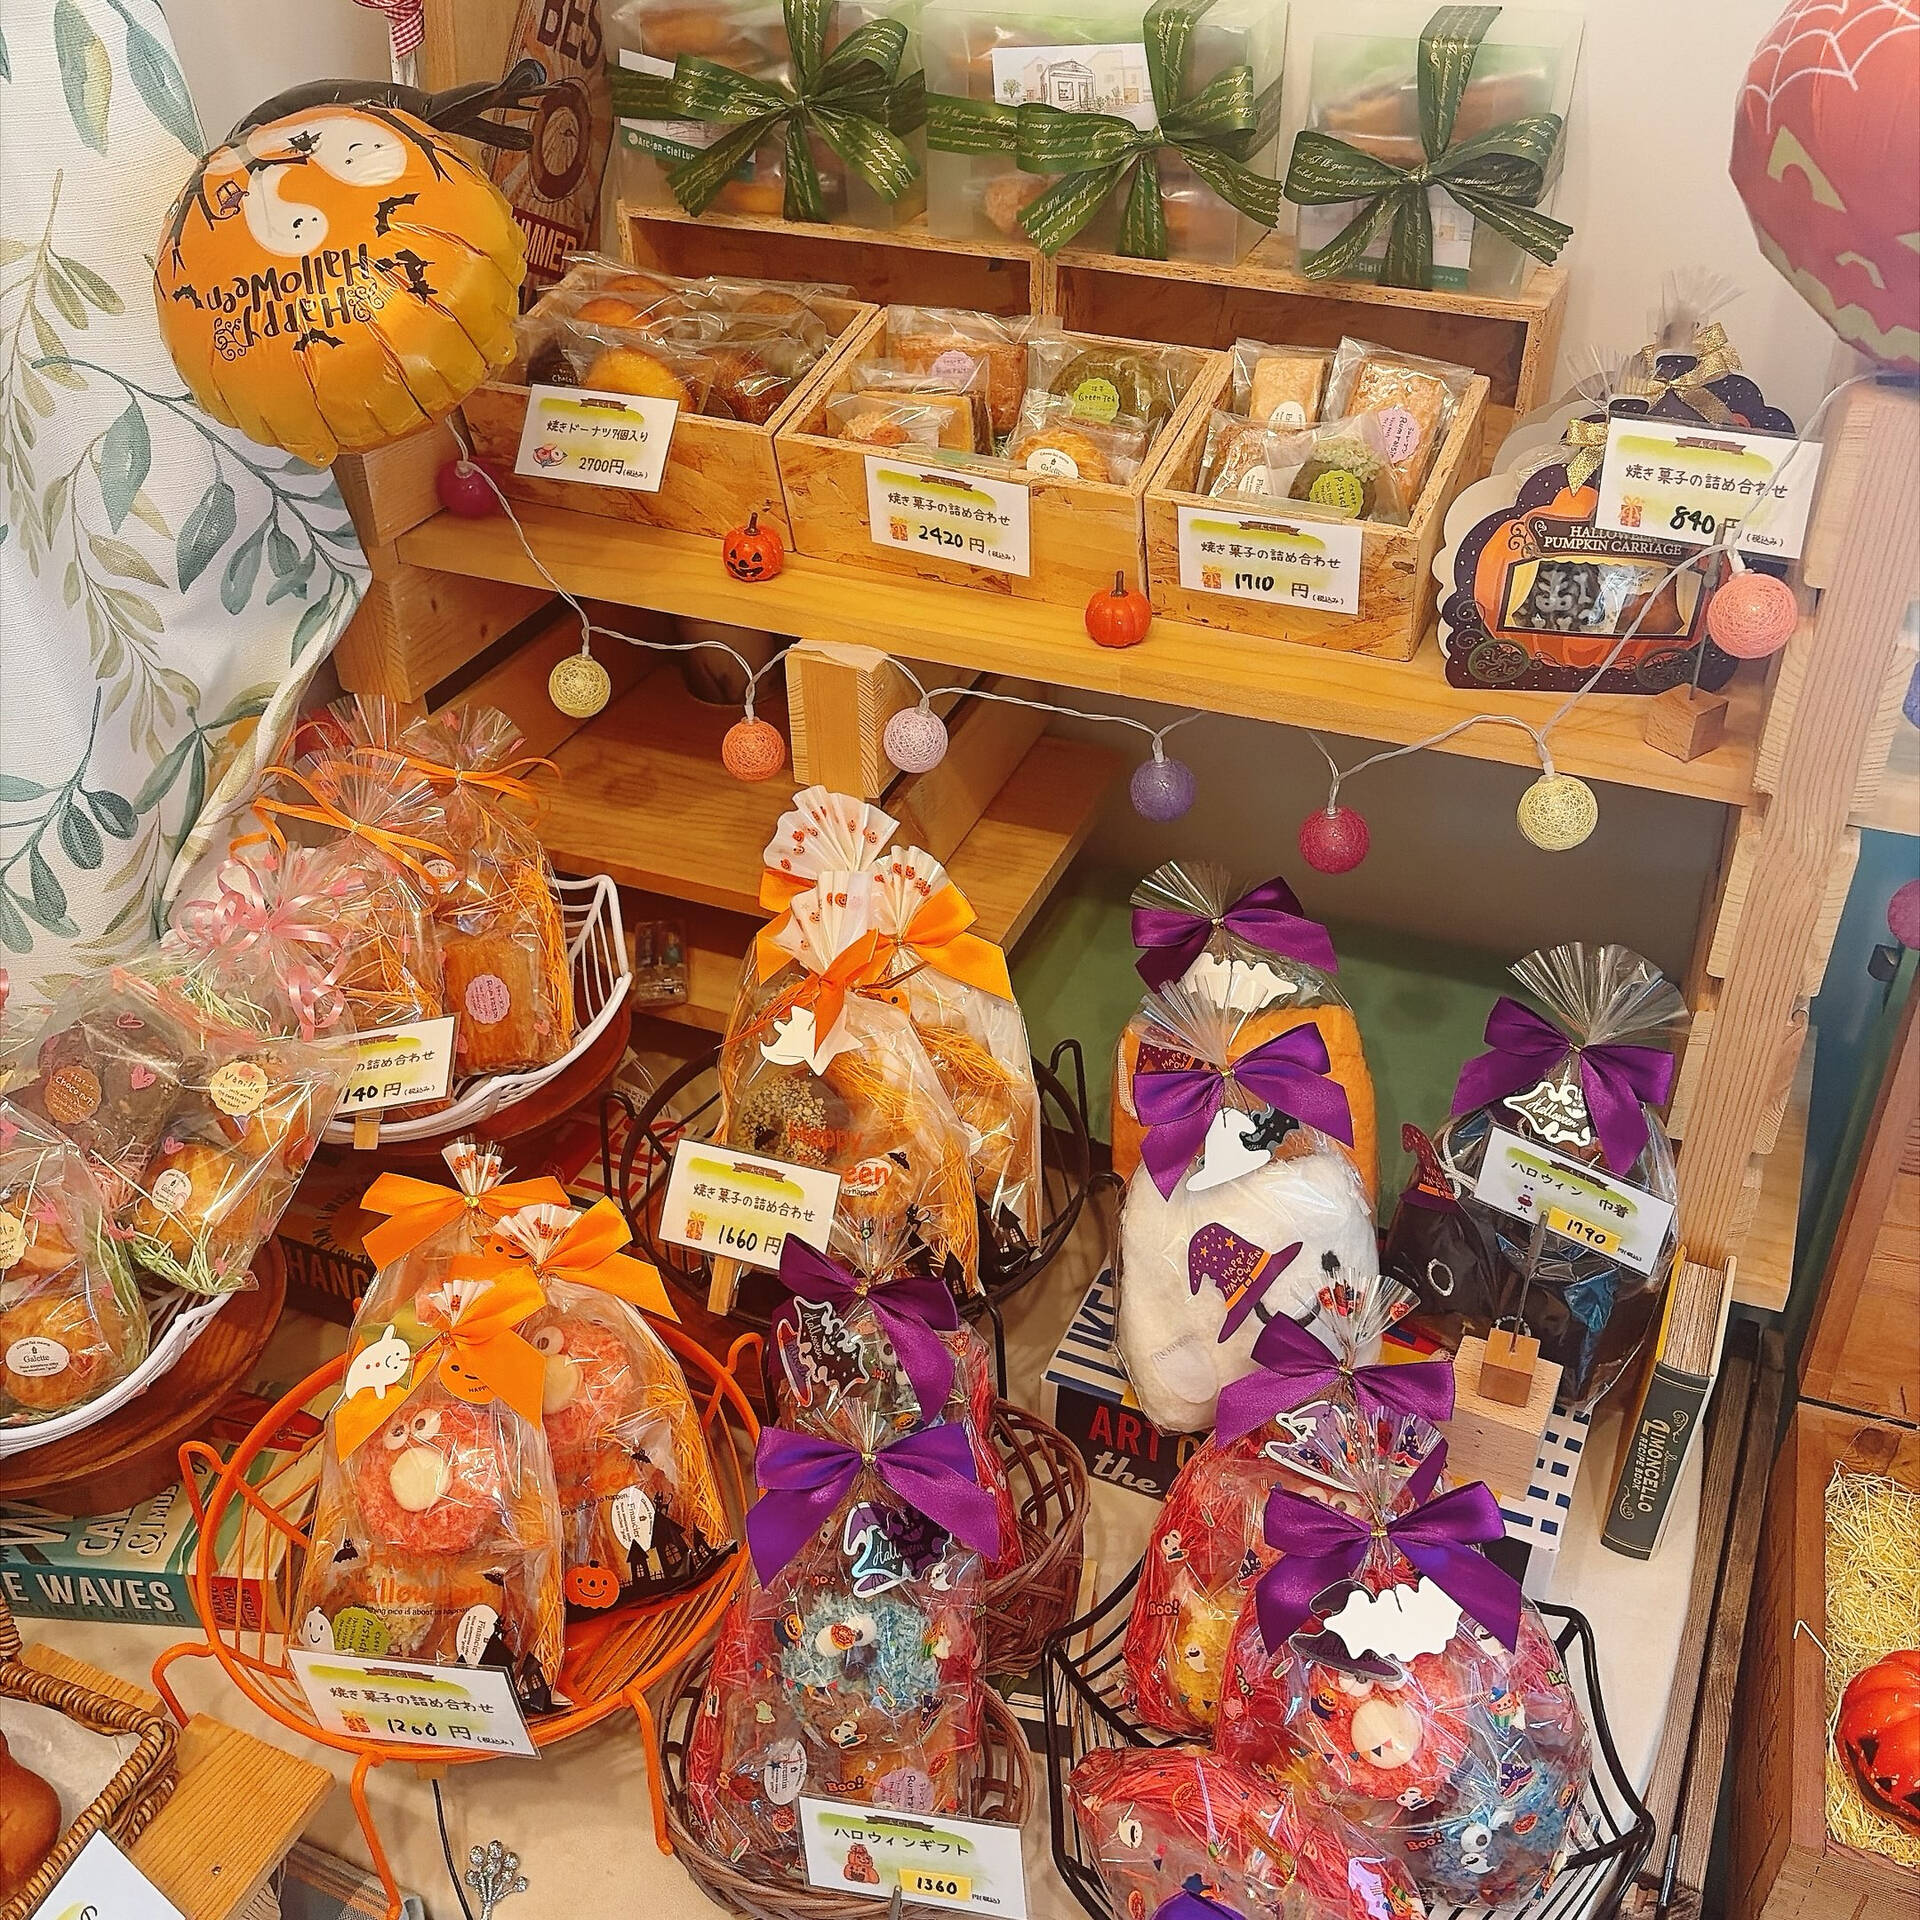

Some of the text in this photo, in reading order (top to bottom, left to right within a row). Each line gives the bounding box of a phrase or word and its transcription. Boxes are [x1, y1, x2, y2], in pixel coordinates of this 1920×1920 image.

[514, 215, 578, 273] MMER
[241, 286, 351, 347] Happy
[1078, 393, 1101, 402] Green
[546, 419, 649, 443] 焼きドーナツ7個入り
[1398, 415, 1409, 437] Rum
[1625, 463, 1788, 499] 焼き菓子の詰め合わせ
[888, 492, 1011, 527] 焼き菓子の詰め合わせ
[1669, 505, 1716, 534] 840
[918, 525, 964, 549] 2420
[969, 537, 985, 554] 円
[1543, 536, 1682, 556] PUMPKIN CARRIAGE
[1200, 541, 1341, 569] 焼き菓子の詰め合わせ
[1235, 572, 1275, 592] 1710
[1291, 582, 1309, 599] 円
[355, 1050, 435, 1072] の詰め合わせ
[224, 1071, 261, 1095] Vanilla
[383, 1082, 402, 1098] 円
[1525, 1097, 1579, 1128] Halloween
[693, 1183, 816, 1223] 焼き菓子の詰め合わせ
[1510, 1160, 1630, 1219] ハロウィン 巾着
[718, 1224, 783, 1257] 1660 円
[1567, 1218, 1607, 1246] 1790
[1221, 1249, 1246, 1281] HAPPY
[1223, 1249, 1263, 1296] HALLOWEEN
[23, 1353, 51, 1364] Galette
[1088, 1404, 1160, 1463] ART
[1093, 1450, 1163, 1495] the
[1631, 1435, 1649, 1491] RECIPE BOOK
[1638, 1417, 1671, 1514] LIMONCELLO
[36, 1573, 176, 1613] WAVES
[1149, 1601, 1180, 1616] Boo!
[330, 1686, 495, 1715] 焼き菓子の詰め合わせ
[386, 1717, 438, 1738] 1260
[449, 1724, 472, 1741] 円
[825, 1775, 865, 1794] Boo!
[833, 1825, 970, 1858] ハロウィンギフト
[1406, 1831, 1444, 1852] Boo!
[916, 1876, 959, 1896] 1360
